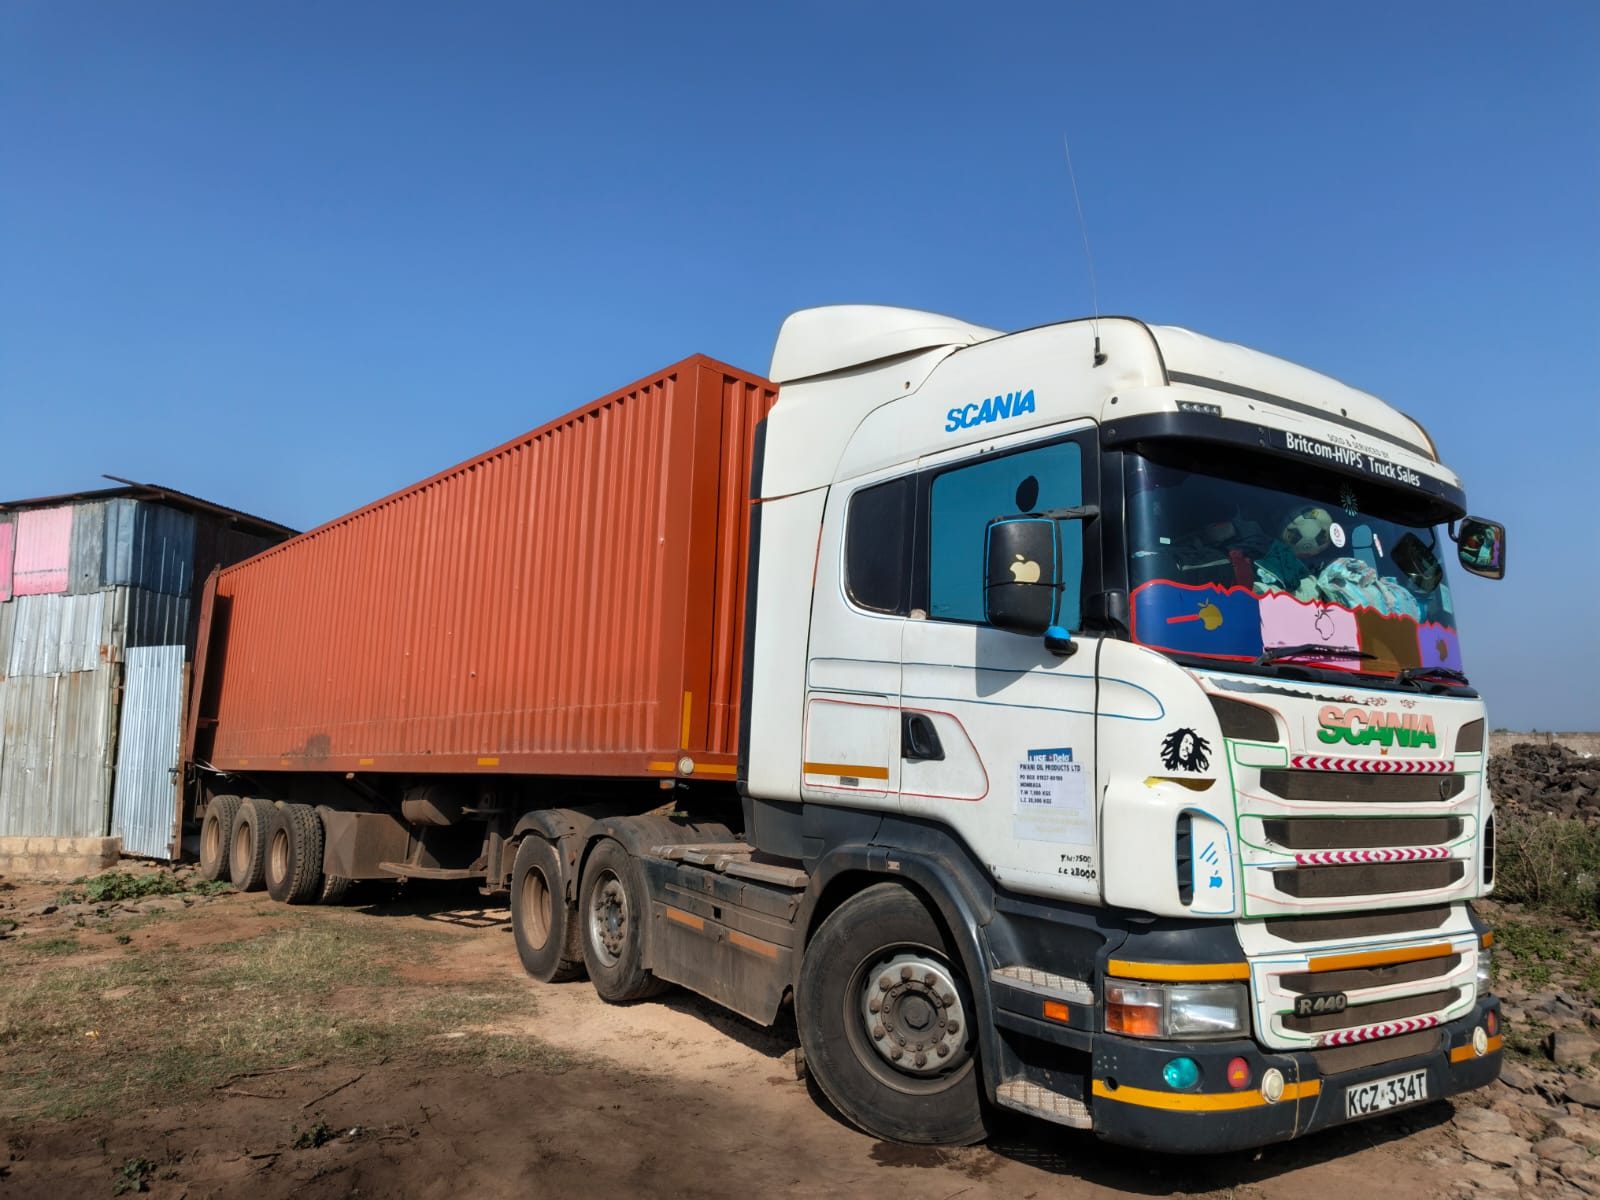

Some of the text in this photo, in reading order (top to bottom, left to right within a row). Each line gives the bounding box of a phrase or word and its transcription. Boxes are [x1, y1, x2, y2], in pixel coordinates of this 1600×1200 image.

[945, 389, 1035, 432] SCANIA
[1286, 432, 1421, 487] Britcom-HVPS Truck Sales
[1317, 705, 1437, 748] SCANIA
[1299, 994, 1346, 1014] R 440
[1348, 1072, 1426, 1116] KCZ 334T
